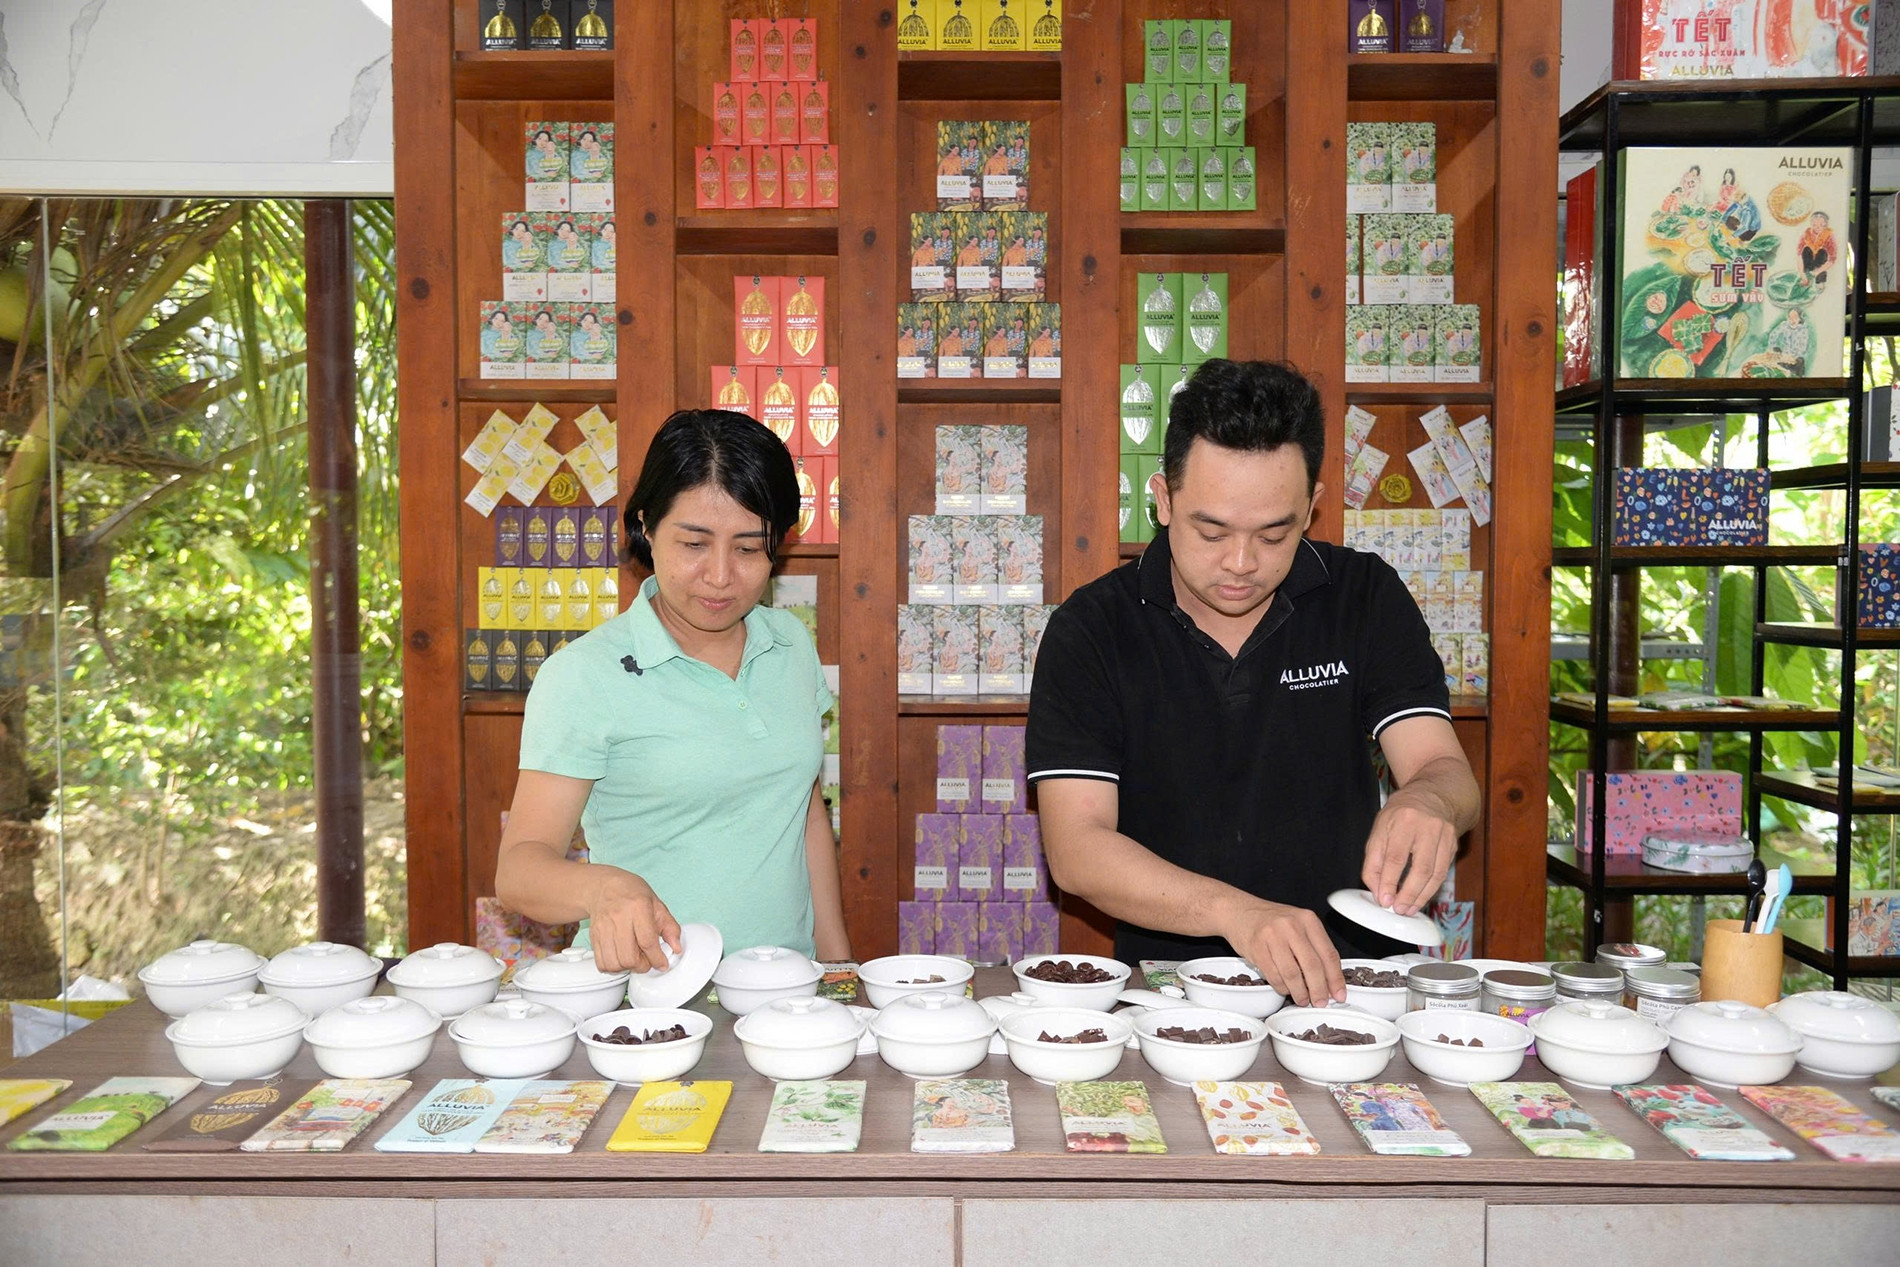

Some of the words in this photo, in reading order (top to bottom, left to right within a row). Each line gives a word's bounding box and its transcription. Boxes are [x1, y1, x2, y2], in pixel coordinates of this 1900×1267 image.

[1671, 9, 1731, 43] TẾT
[1672, 64, 1734, 76] ALLUVIA
[1778, 156, 1843, 169] ALLUVIA
[1710, 255, 1767, 288] TẾT
[1708, 519, 1757, 530] ALLUVIA
[1280, 660, 1349, 684] ALLUVIA
[1289, 679, 1339, 691] CHOCOLATIER
